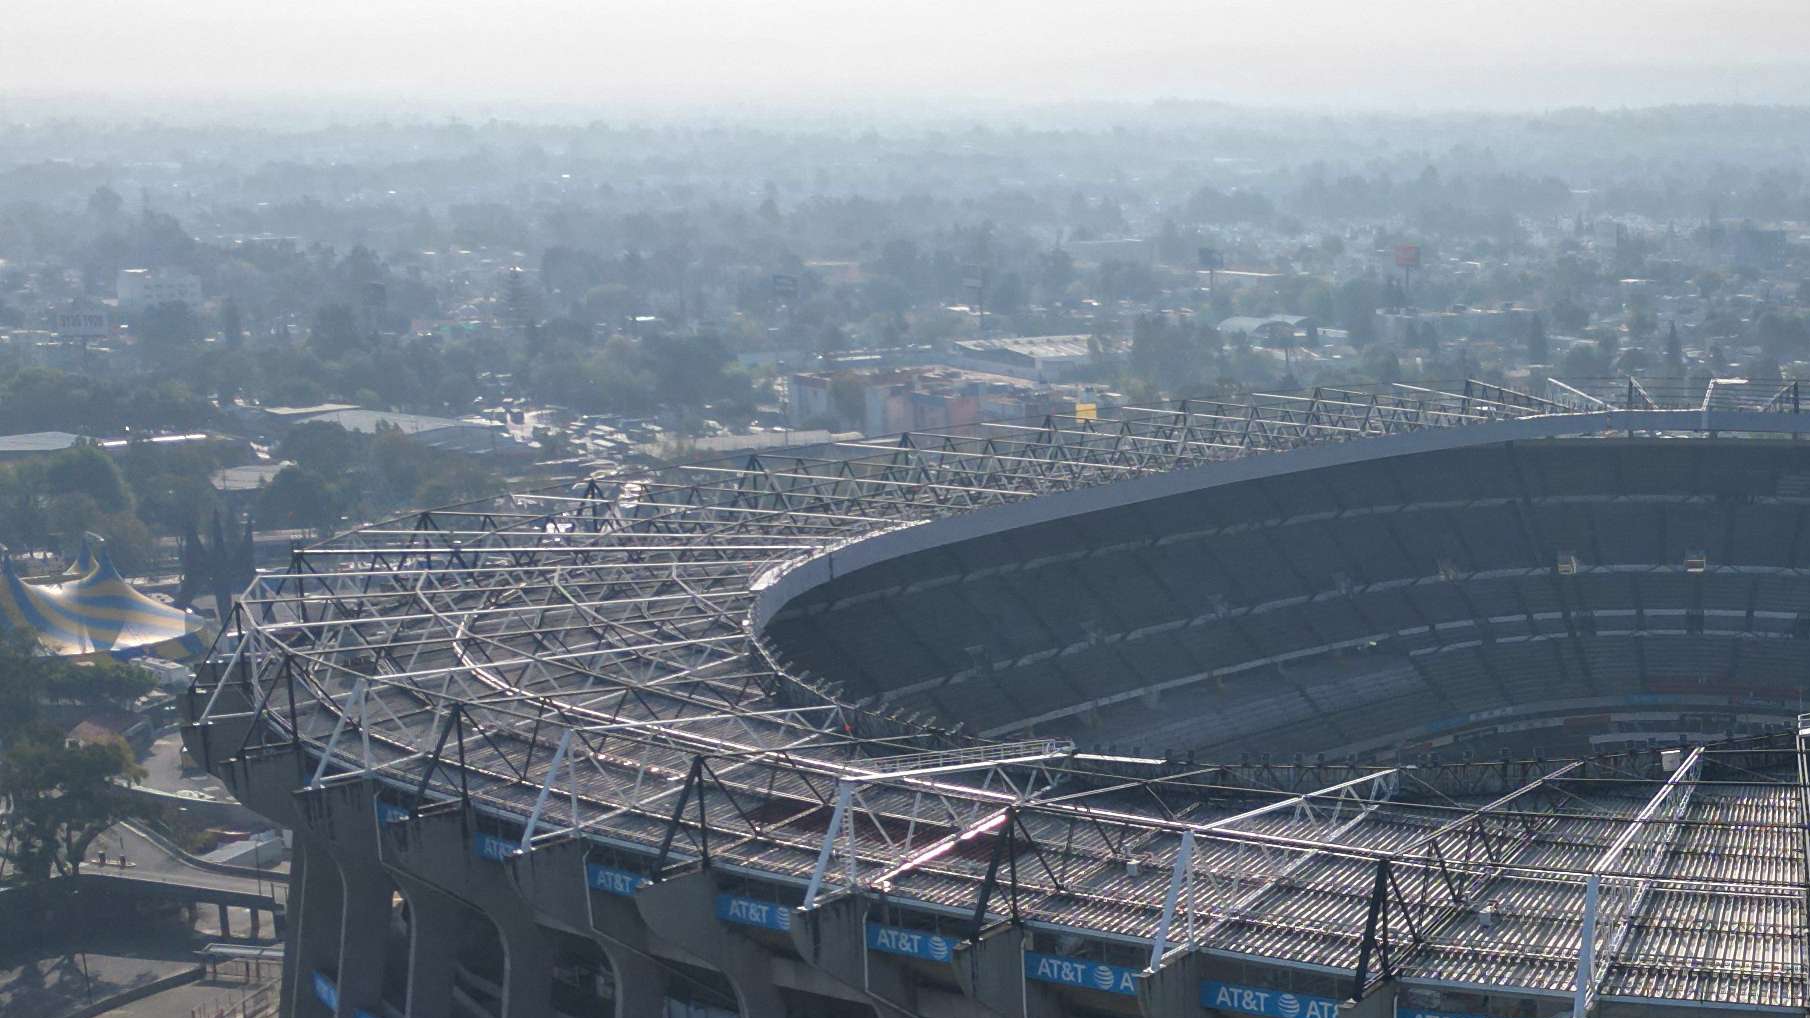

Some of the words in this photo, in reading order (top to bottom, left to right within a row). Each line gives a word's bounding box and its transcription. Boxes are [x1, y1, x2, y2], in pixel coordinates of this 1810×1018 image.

[597, 870, 632, 893] AT&T
[729, 900, 767, 924] AT&T
[877, 928, 921, 951] AT&T
[1038, 959, 1086, 983] AT&T
[1216, 987, 1269, 1012] AT&T
